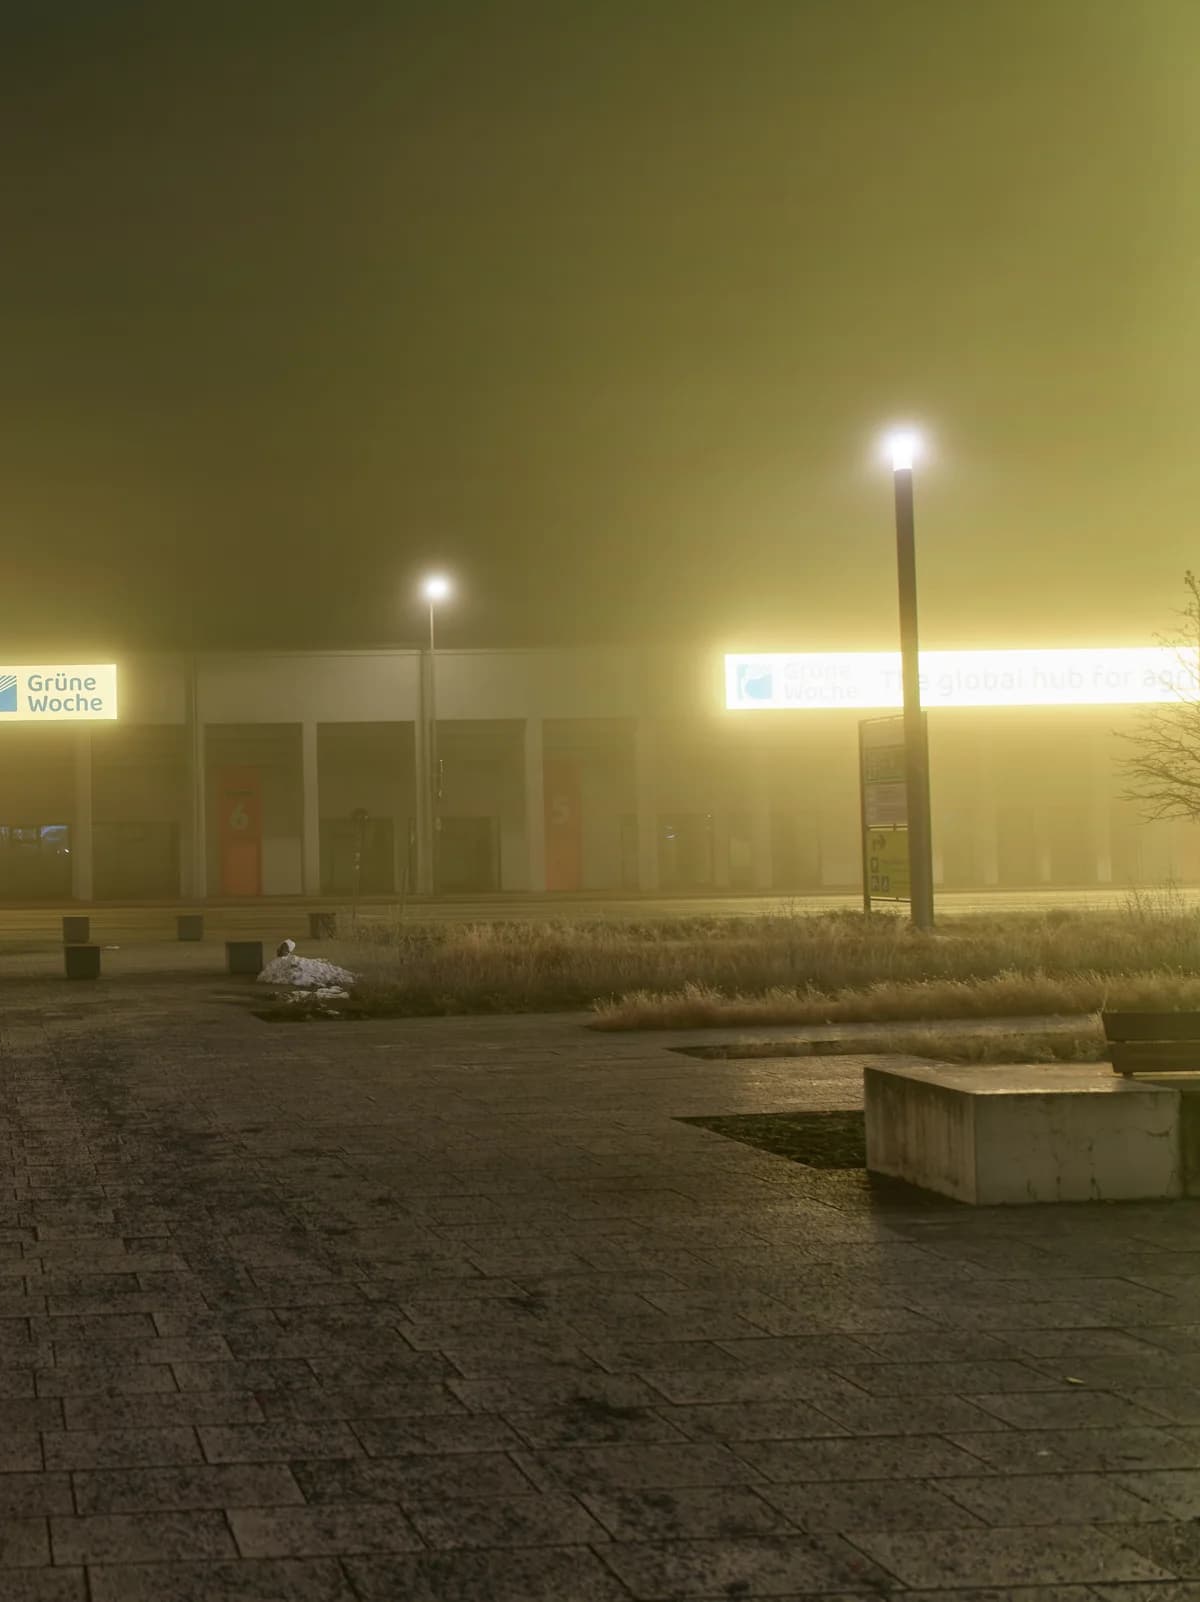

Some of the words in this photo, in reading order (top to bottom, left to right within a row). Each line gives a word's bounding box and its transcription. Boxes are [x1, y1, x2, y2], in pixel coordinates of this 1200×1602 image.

[27, 674, 97, 692] Grüne
[1032, 664, 1084, 689] hub
[27, 693, 103, 712] Woche
[228, 801, 250, 830] 6
